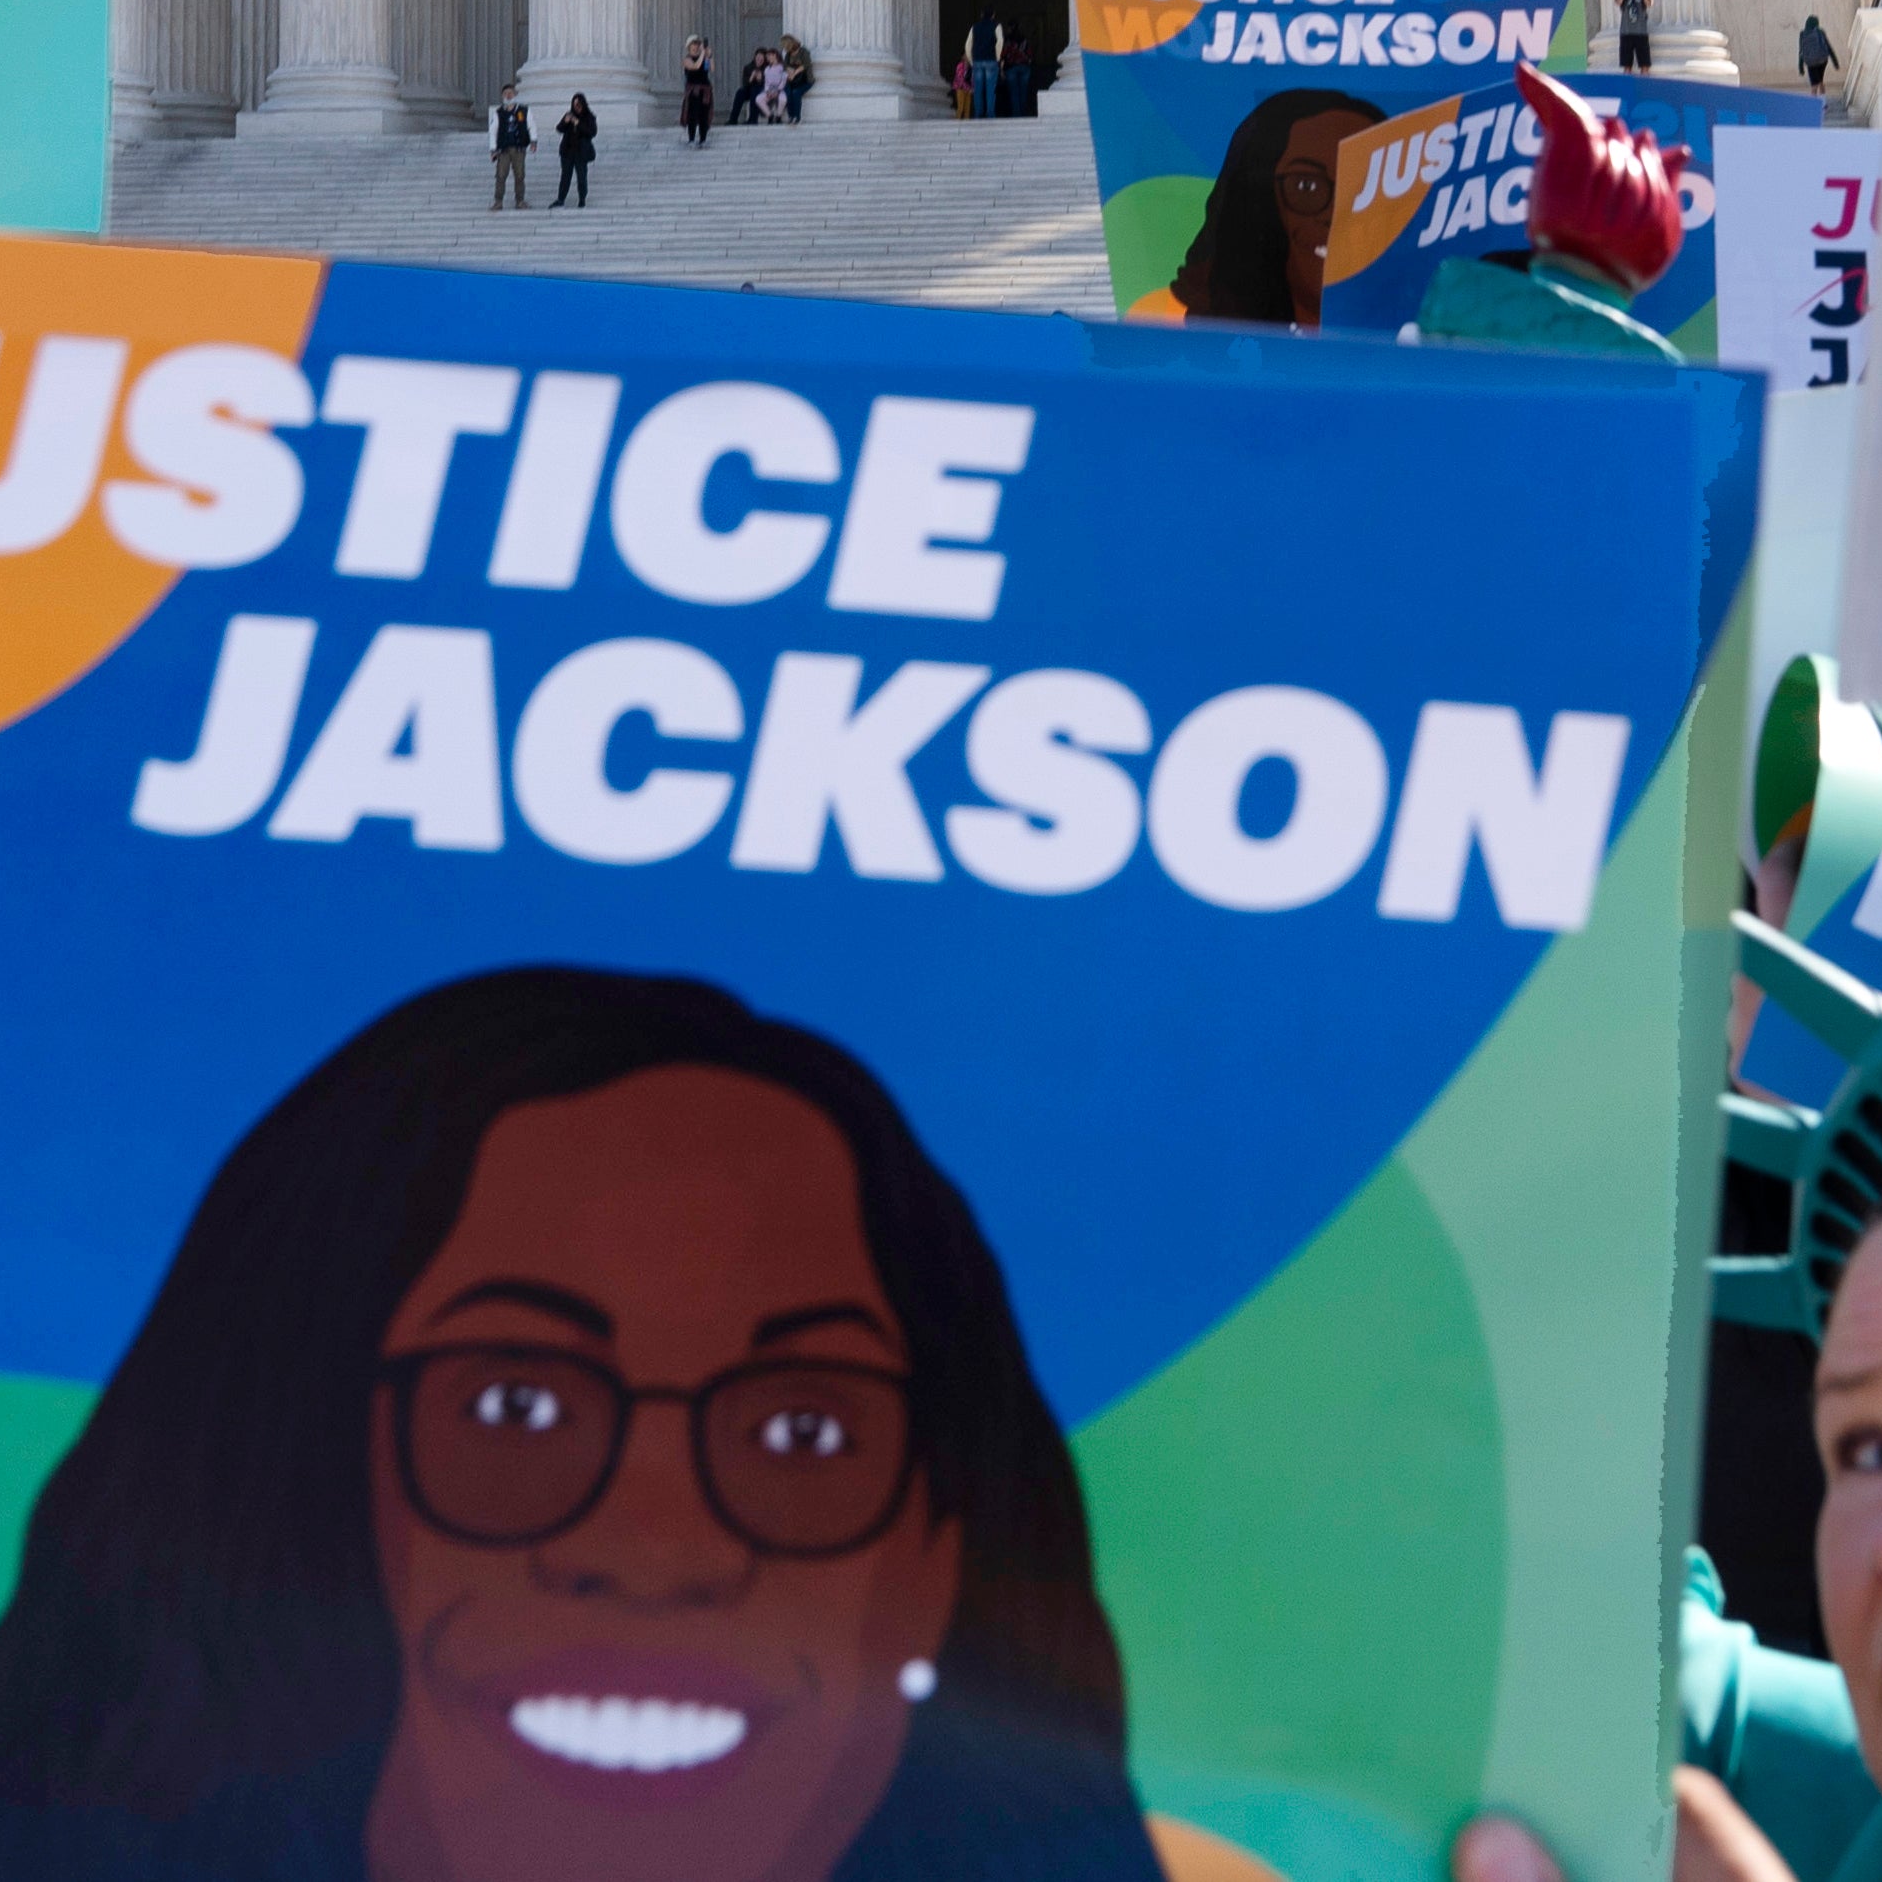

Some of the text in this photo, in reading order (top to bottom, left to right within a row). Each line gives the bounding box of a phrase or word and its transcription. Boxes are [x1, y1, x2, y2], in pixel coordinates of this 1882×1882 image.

[1202, 8, 1553, 66] JACKSON
[1351, 97, 1622, 214] JUSTIC
[135, 617, 1628, 930] JACKSON
